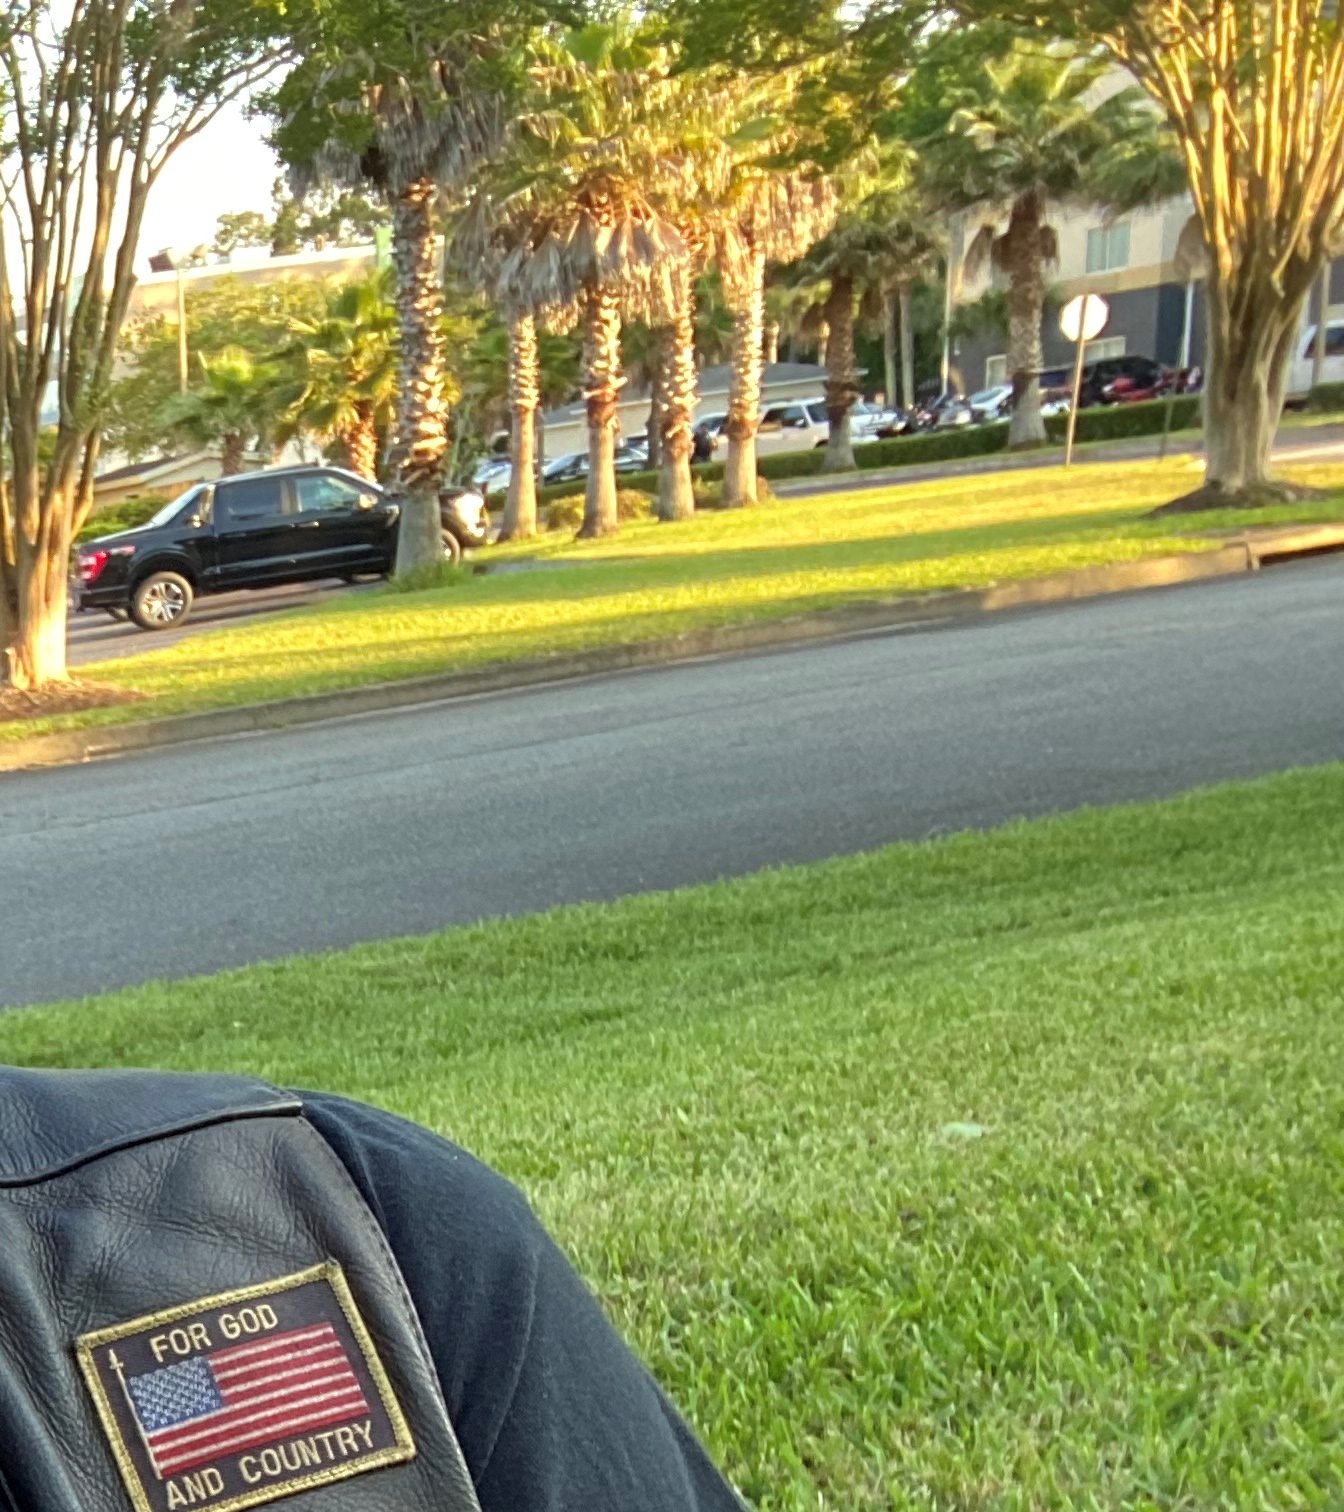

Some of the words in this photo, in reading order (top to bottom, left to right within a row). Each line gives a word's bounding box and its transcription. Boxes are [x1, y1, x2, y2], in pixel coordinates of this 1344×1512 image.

[149, 1323, 212, 1363] FOR
[218, 1303, 279, 1340] GOD
[165, 1467, 225, 1511] AND
[238, 1419, 374, 1484] COUNTRY
